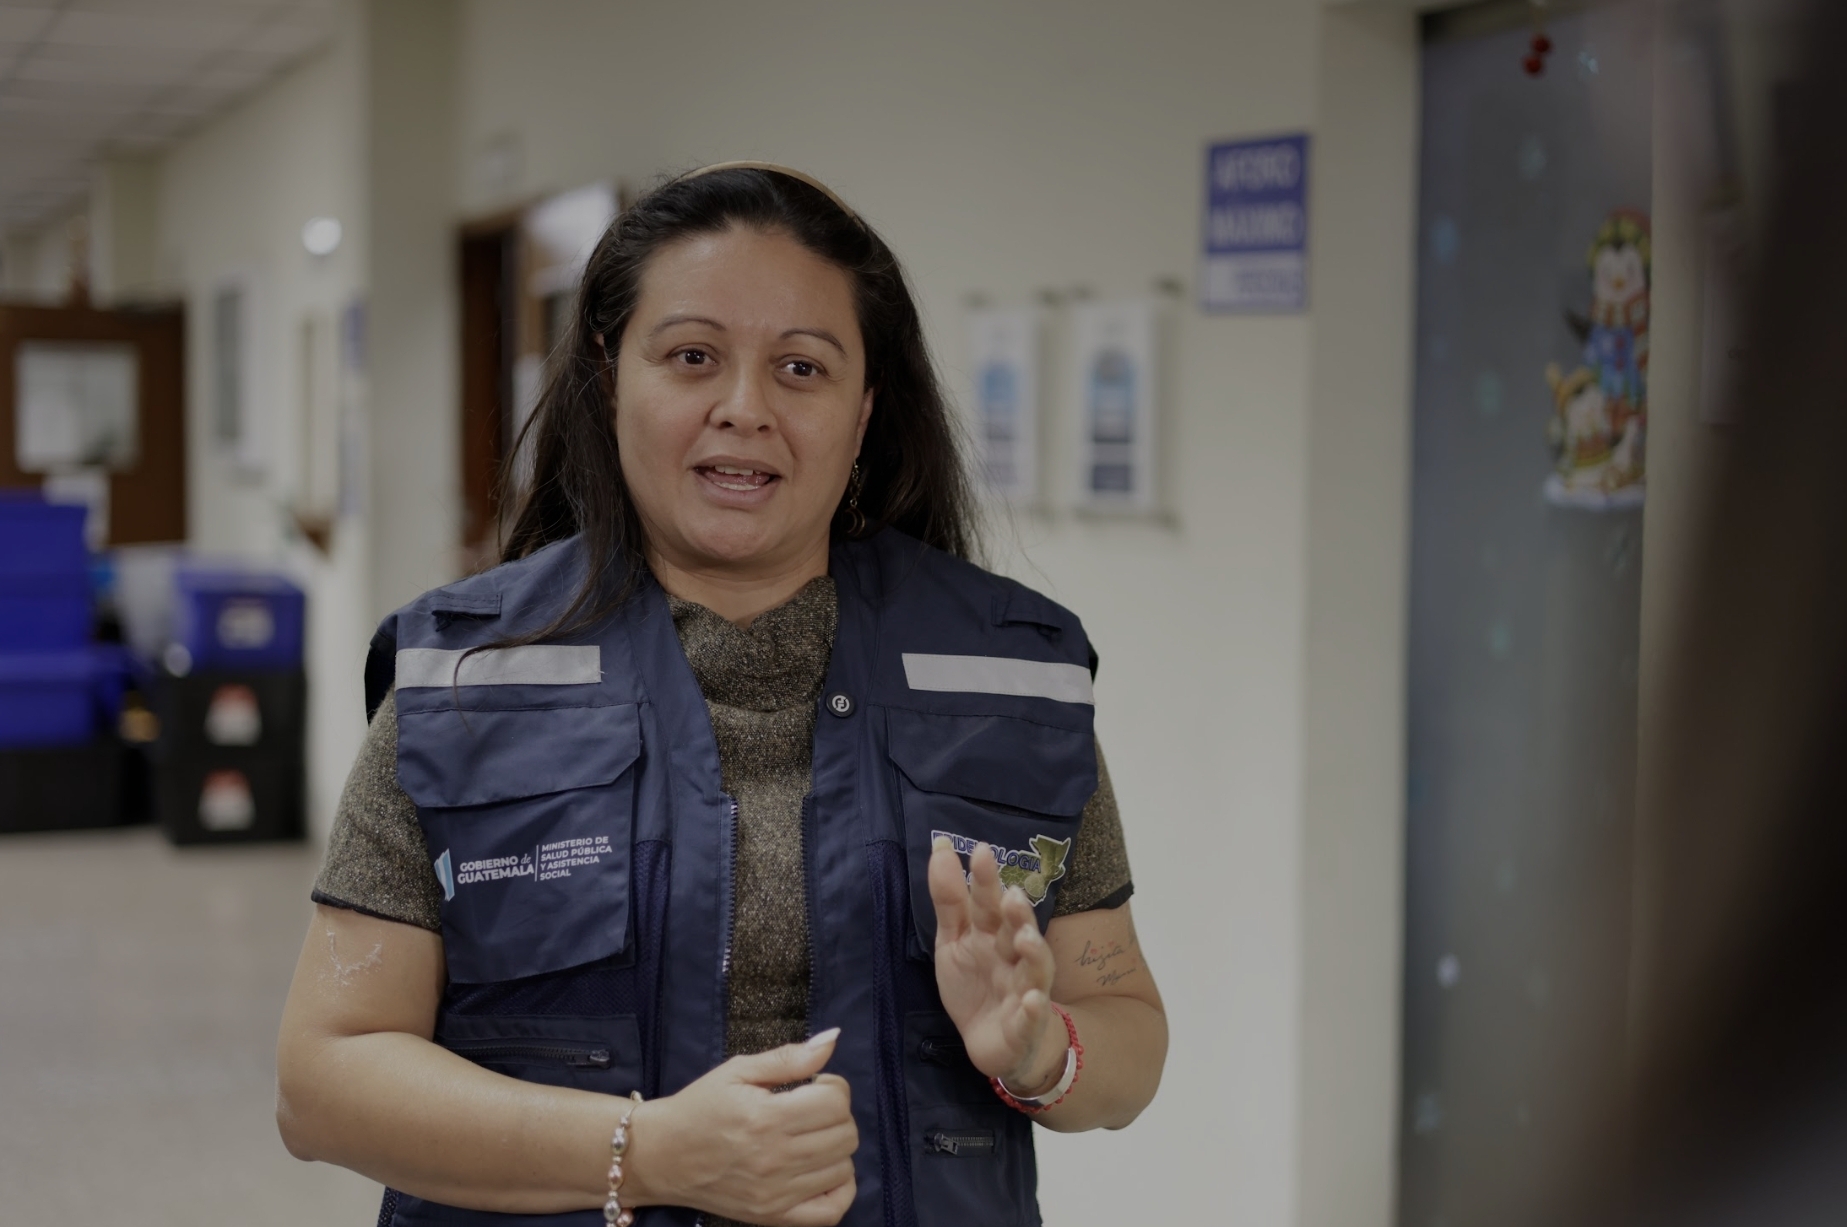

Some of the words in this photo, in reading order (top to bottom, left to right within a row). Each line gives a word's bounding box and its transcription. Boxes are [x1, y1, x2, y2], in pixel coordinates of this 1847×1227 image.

[541, 837, 593, 852] MINISTERIO
[595, 836, 609, 845] DE
[932, 831, 1042, 874] IDELOGIA
[540, 850, 569, 862] SALUD
[570, 845, 613, 858] PÚBLICA
[459, 855, 519, 873] GOBIERNO
[520, 853, 532, 865] de
[540, 863, 546, 871] Y
[547, 855, 600, 871] ASISTENCIA
[457, 864, 535, 885] GUATEMALA
[540, 869, 572, 881] SOCIAL
